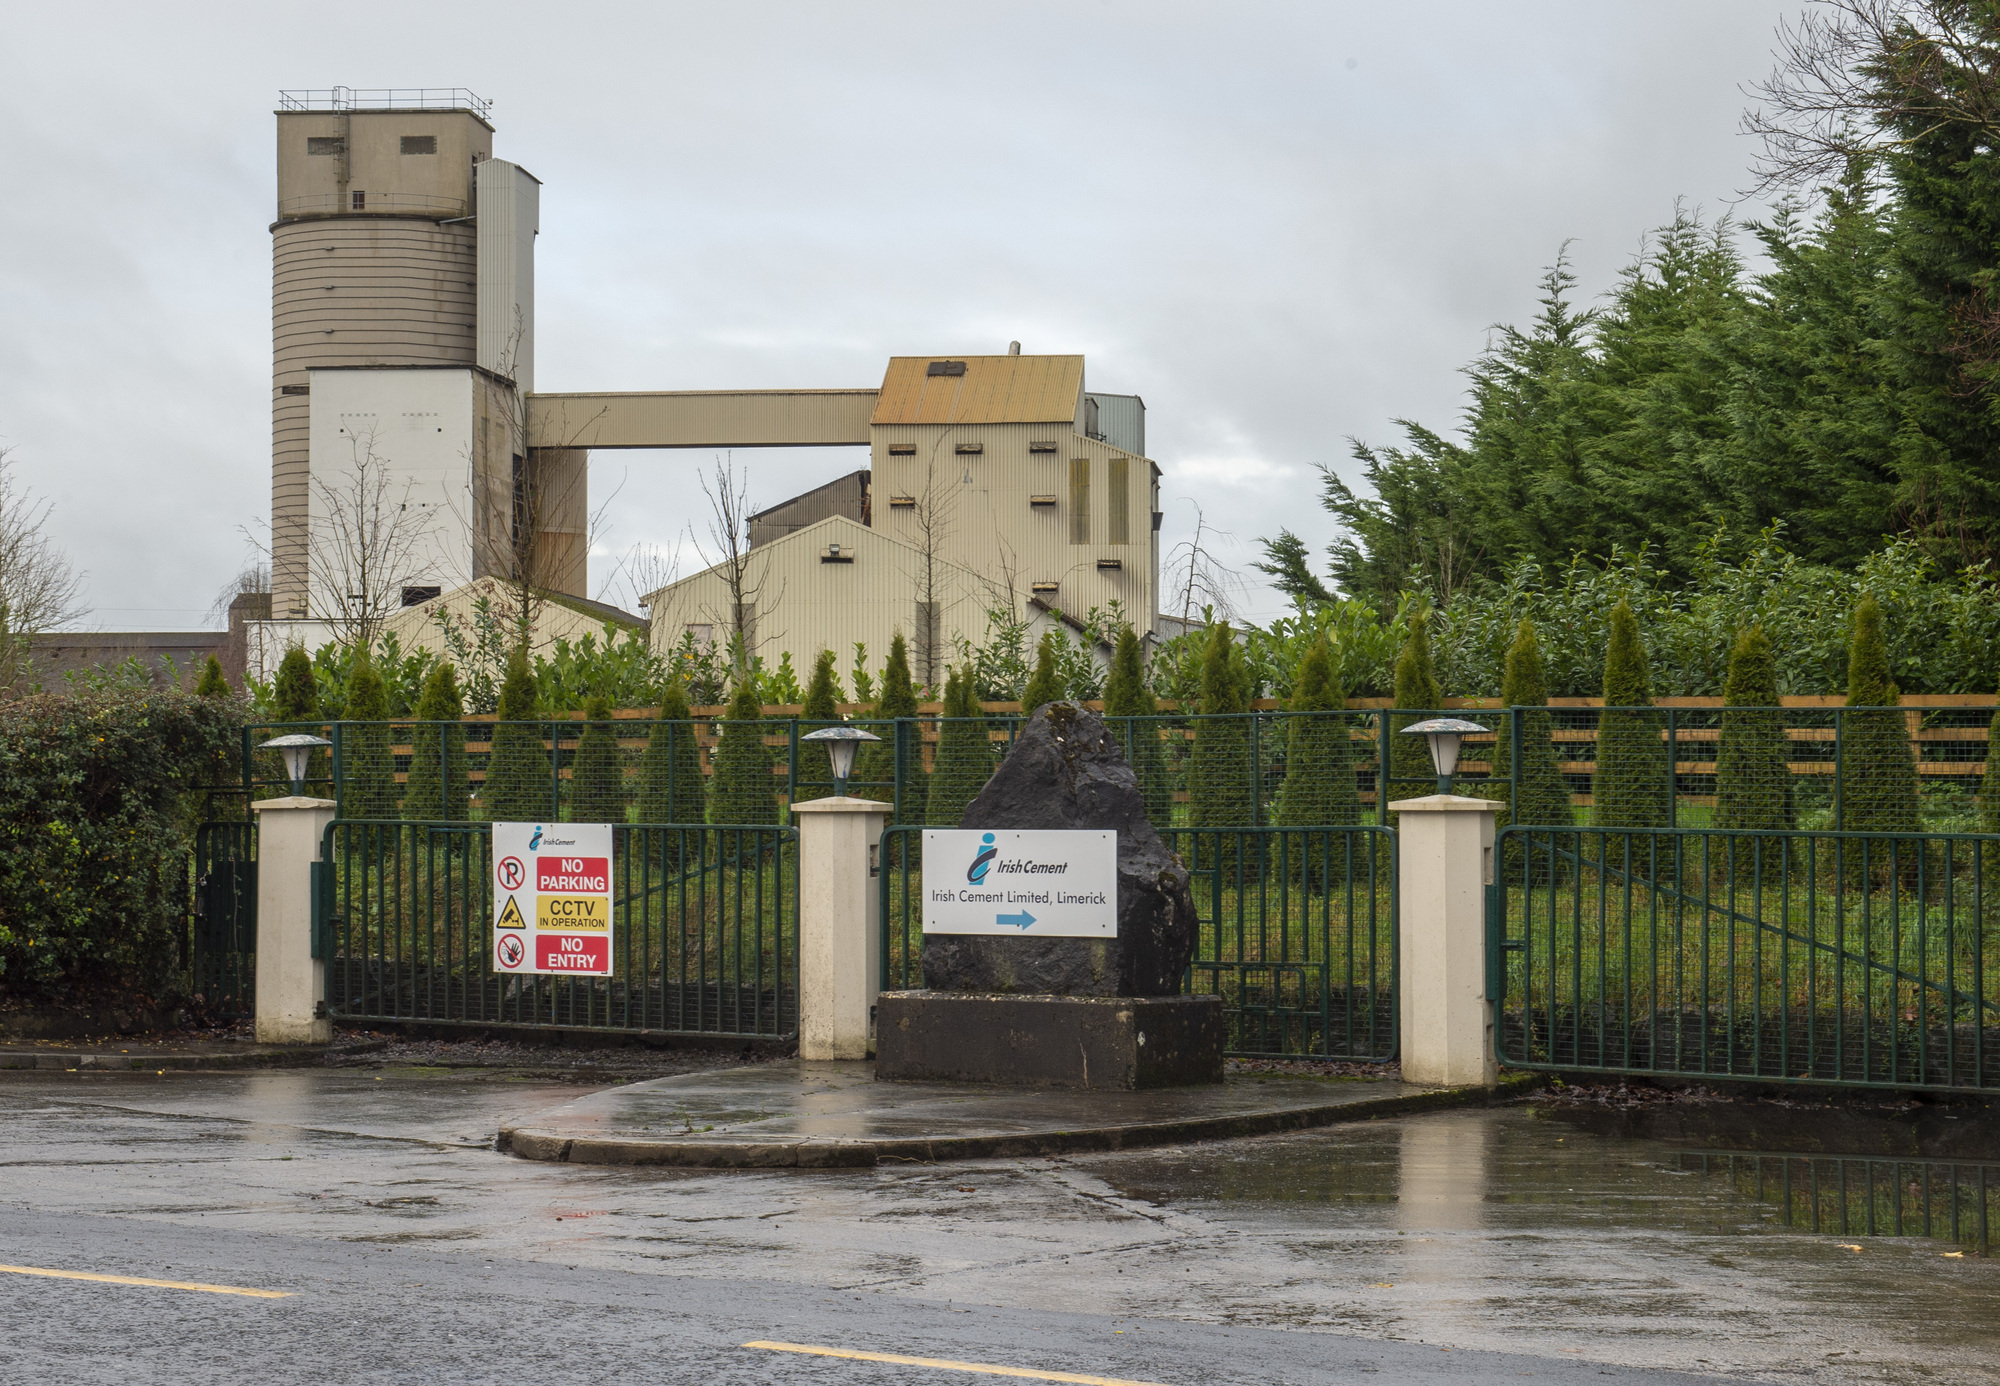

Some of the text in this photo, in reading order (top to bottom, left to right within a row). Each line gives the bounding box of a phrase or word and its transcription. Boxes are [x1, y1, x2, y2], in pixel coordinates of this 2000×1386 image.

[562, 859, 583, 873] NO
[540, 876, 604, 890] PARKING
[932, 890, 1106, 906] Irish Cement Limited, Limerick
[550, 900, 595, 916] CCTV
[540, 918, 604, 928] IN OPERATION
[561, 938, 583, 952] NO
[548, 954, 596, 968] ENTRY
